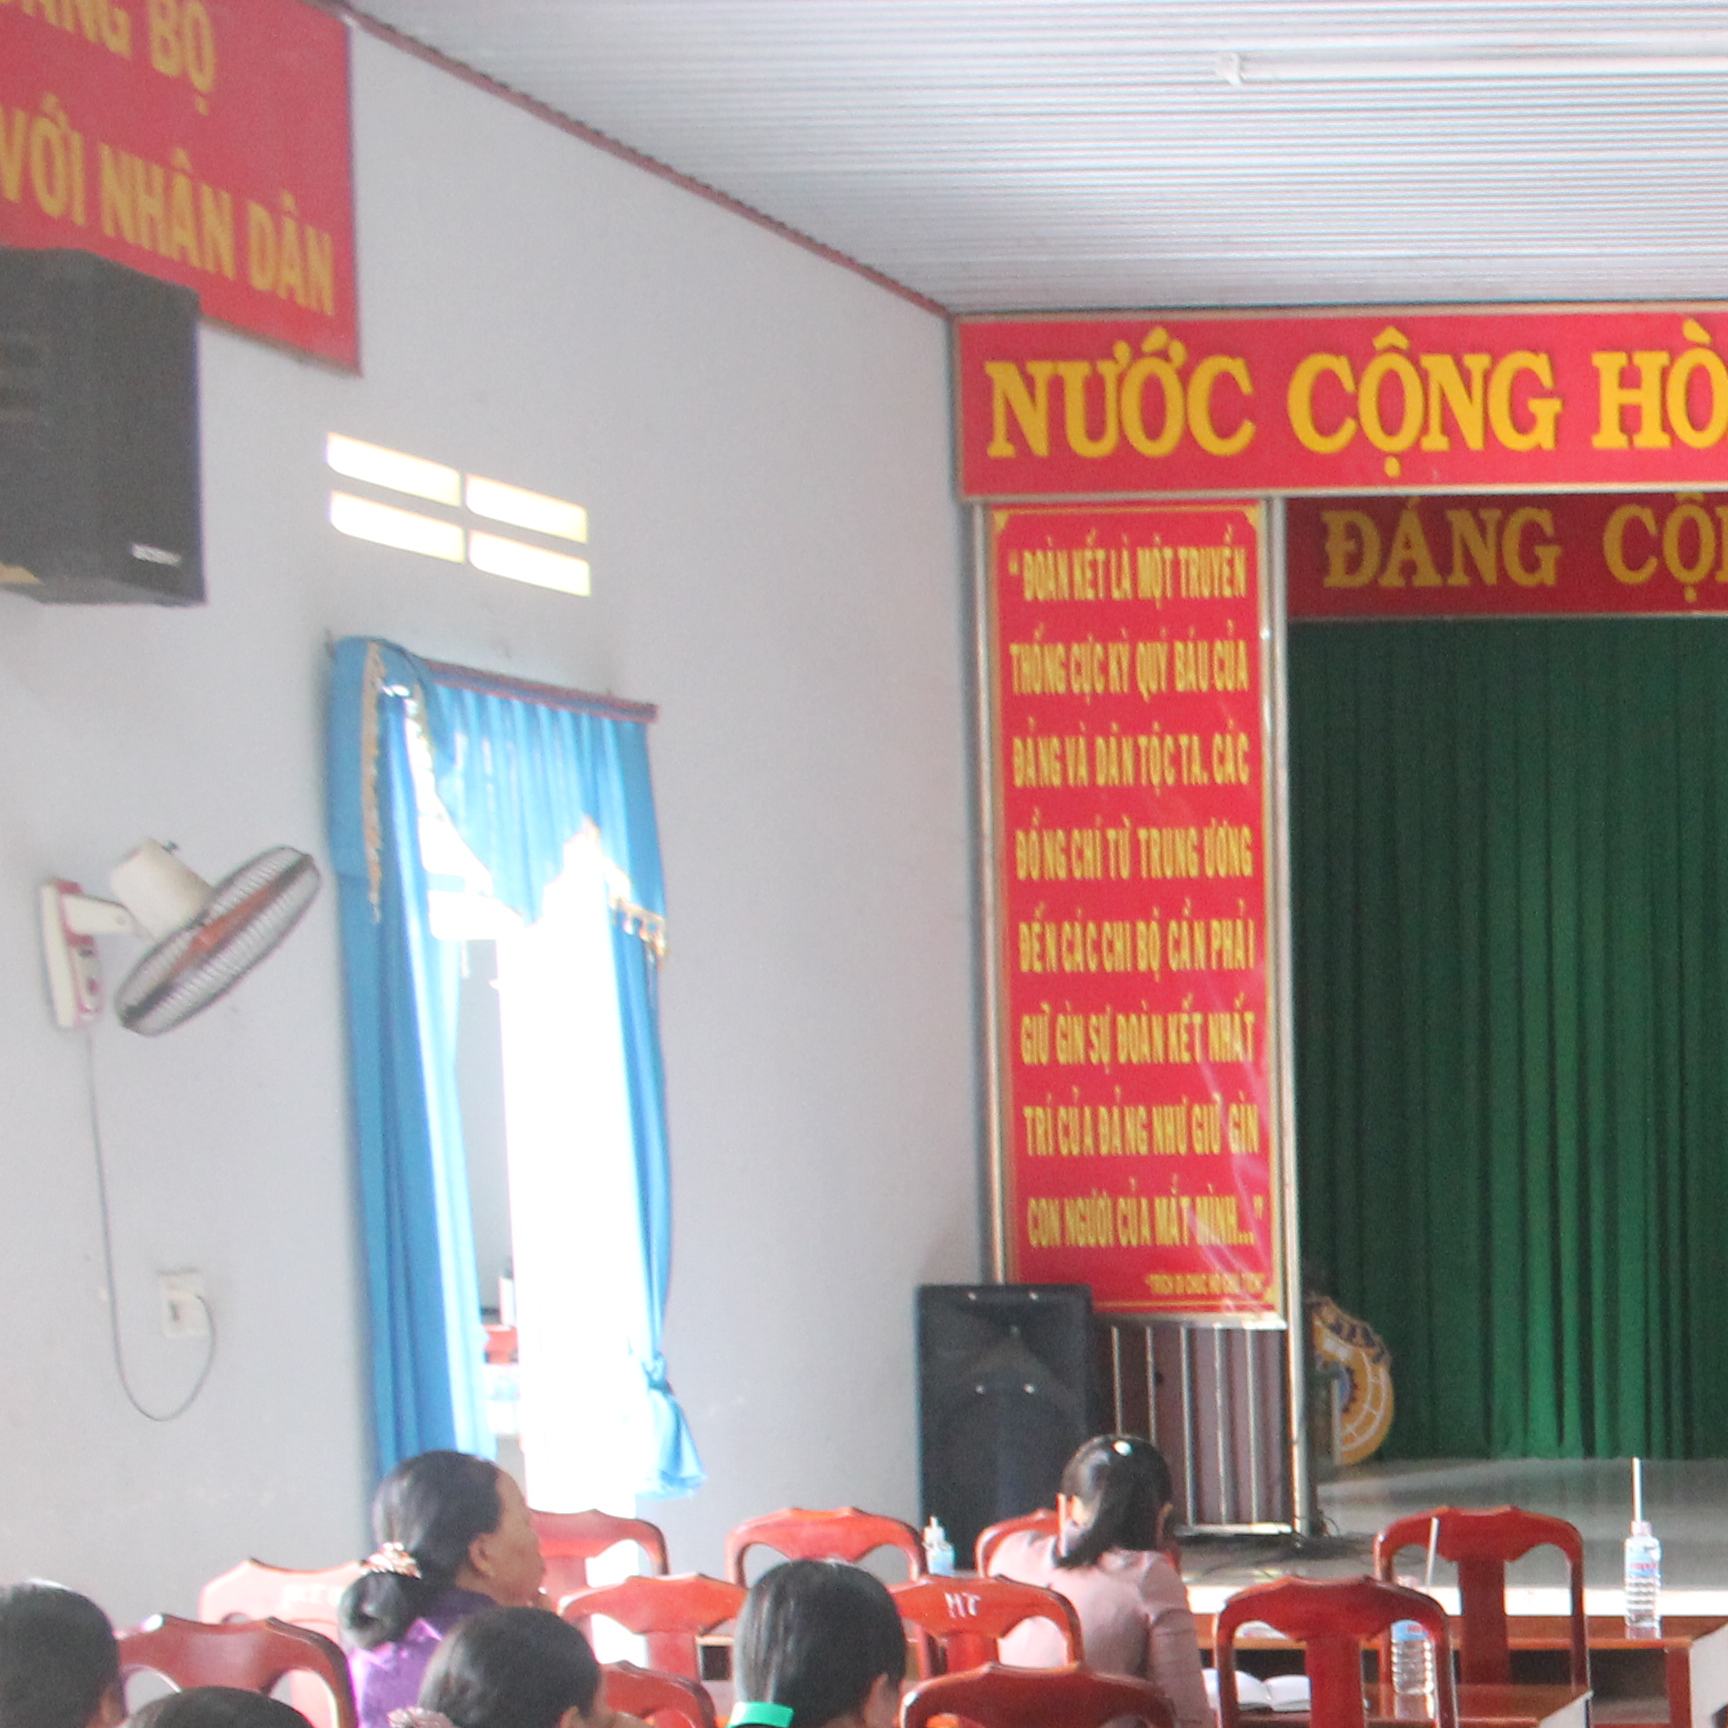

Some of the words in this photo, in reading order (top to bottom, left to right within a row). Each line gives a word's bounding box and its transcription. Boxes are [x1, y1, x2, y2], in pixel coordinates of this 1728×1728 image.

[0, 94, 85, 226] VỚI
[101, 143, 235, 279] NHÂN
[248, 191, 333, 315] DÂN
[986, 327, 1255, 458] NƯỚC
[1288, 327, 1563, 478] CỘNG
[1108, 537, 1134, 600] LÀ
[1137, 535, 1175, 607] MỘT
[1212, 620, 1249, 691] CỦA
[1065, 721, 1089, 786] VÀ
[1095, 723, 1135, 786] DÂN
[1136, 722, 1176, 795] TỘC
[1137, 827, 1200, 878] TRUNG
[1101, 921, 1133, 972] CHI
[1136, 908, 1161, 980] BỘ
[1028, 1198, 1063, 1247] CON
[946, 1591, 981, 1618] HT
